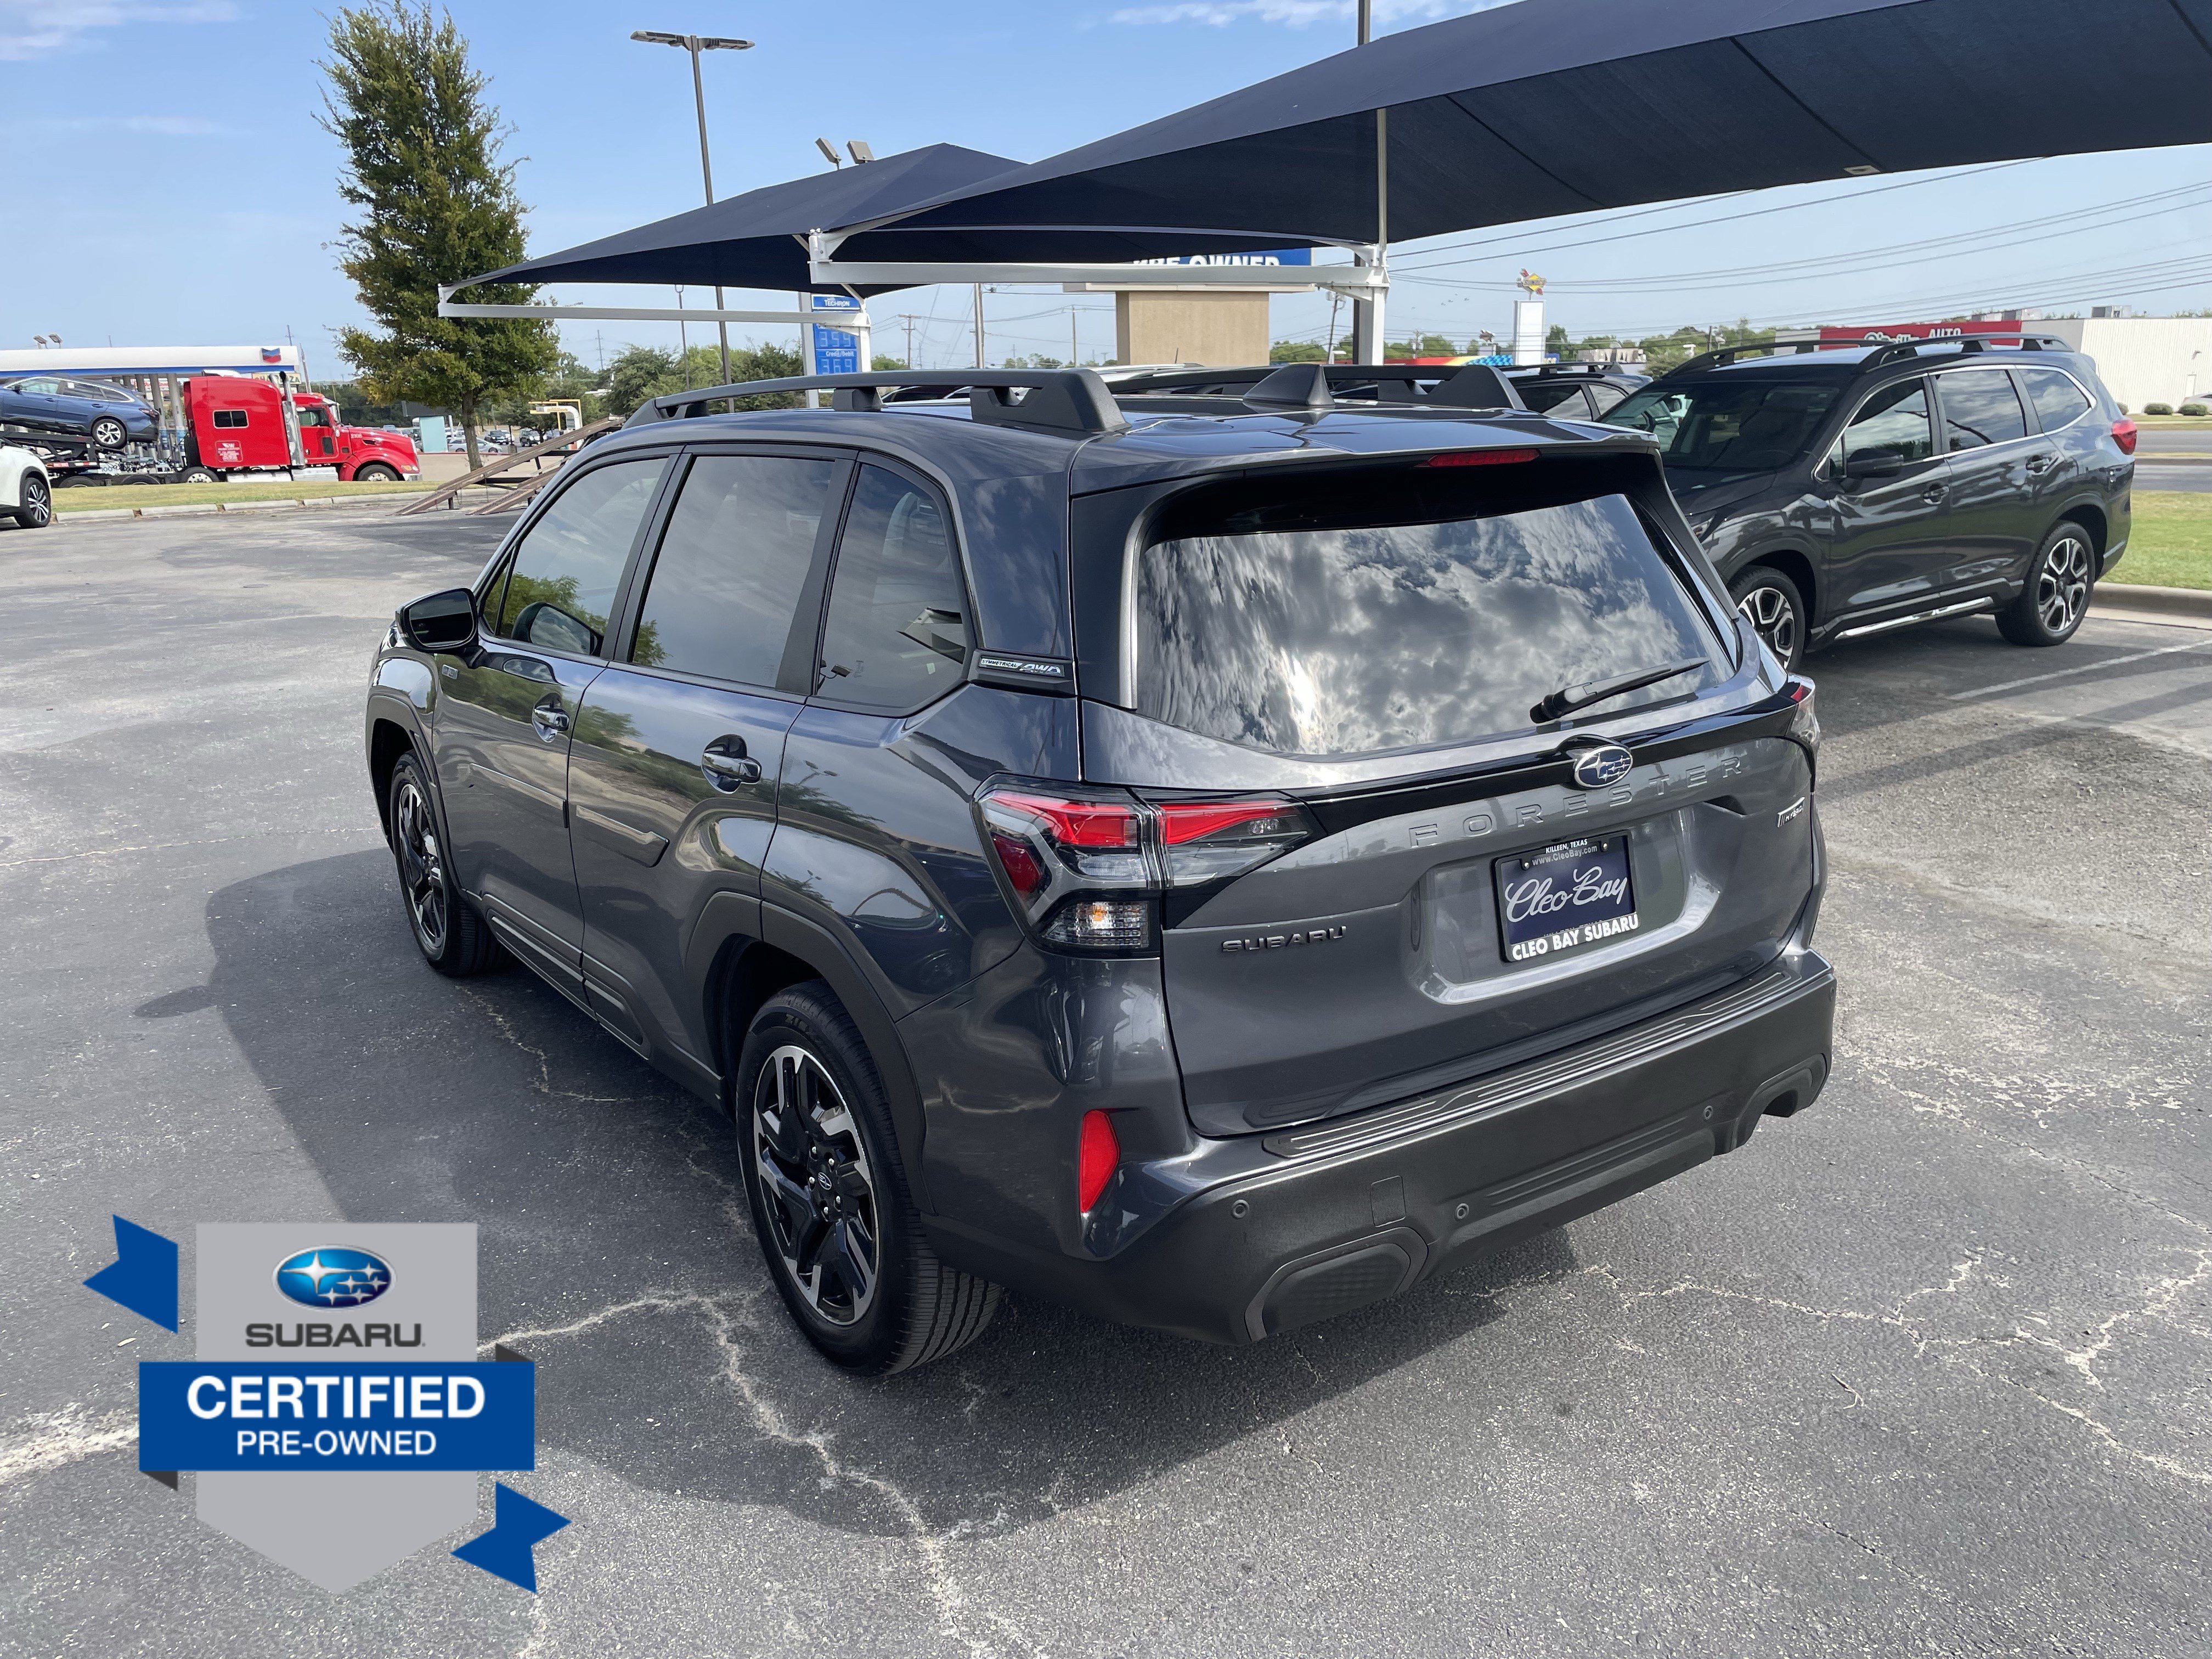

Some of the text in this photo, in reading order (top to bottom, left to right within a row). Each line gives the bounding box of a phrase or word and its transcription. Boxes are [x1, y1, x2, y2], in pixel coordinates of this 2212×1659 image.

[1929, 328, 1961, 338] AUTO
[981, 659, 1062, 674] SYMMETRICAL AWD
[1408, 755, 1742, 849] FORESTER
[1532, 845, 1598, 866] www.CleoBay.com
[1545, 839, 1588, 854] KILLEEN, TEXAS
[1505, 866, 1628, 923] Cleo Bay
[1222, 926, 1347, 952] SUBARU
[1512, 939, 1548, 961] CLEO
[1552, 929, 1579, 951] BAY
[1584, 913, 1639, 942] SUBARU
